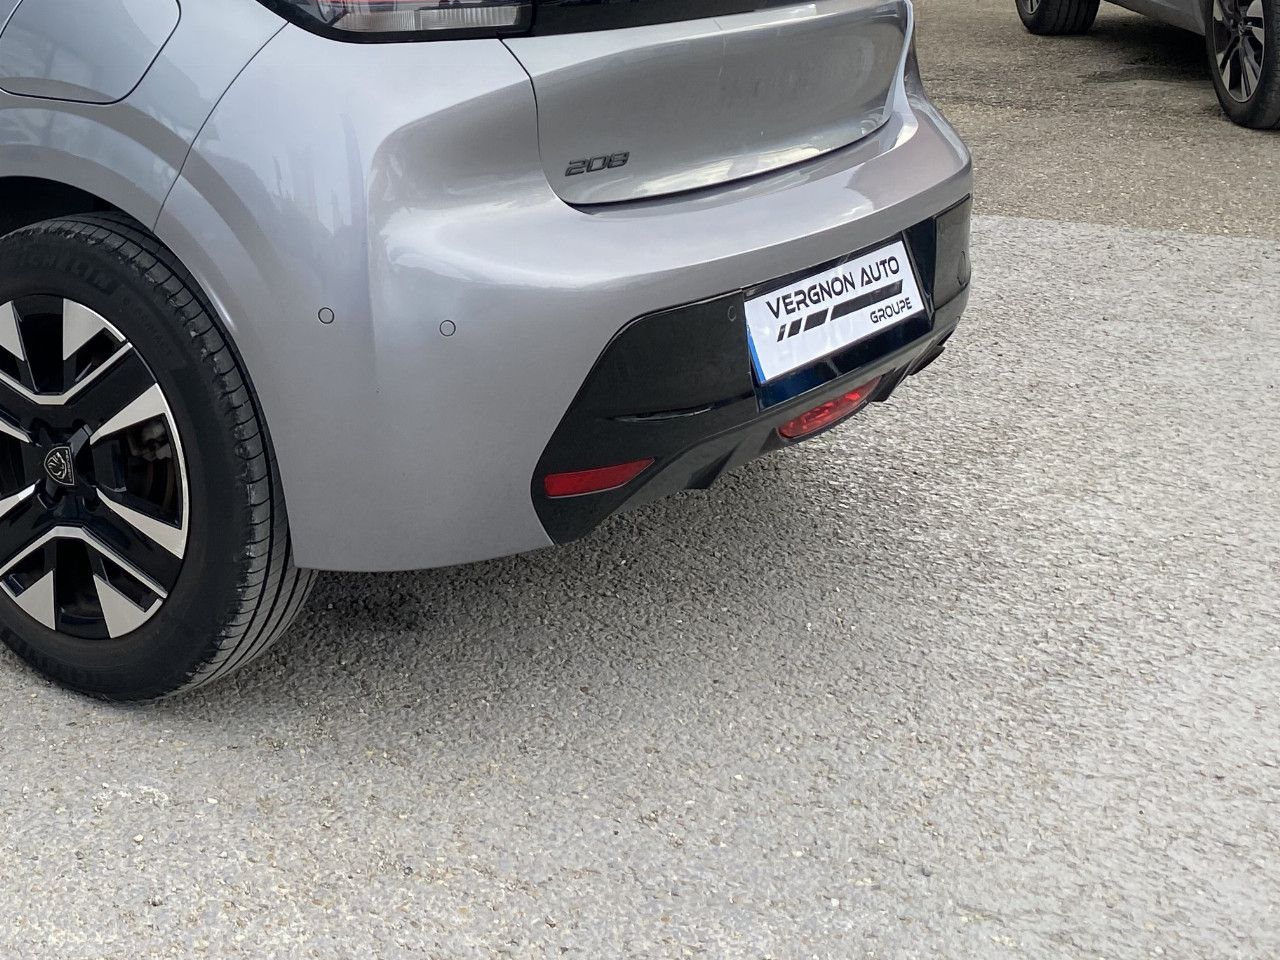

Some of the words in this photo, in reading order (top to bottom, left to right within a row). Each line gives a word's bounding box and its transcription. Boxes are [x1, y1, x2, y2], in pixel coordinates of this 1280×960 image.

[564, 151, 630, 176] 208
[765, 271, 856, 320] VERGNON
[860, 256, 900, 287] AUTO
[870, 297, 912, 323] GROUPE
